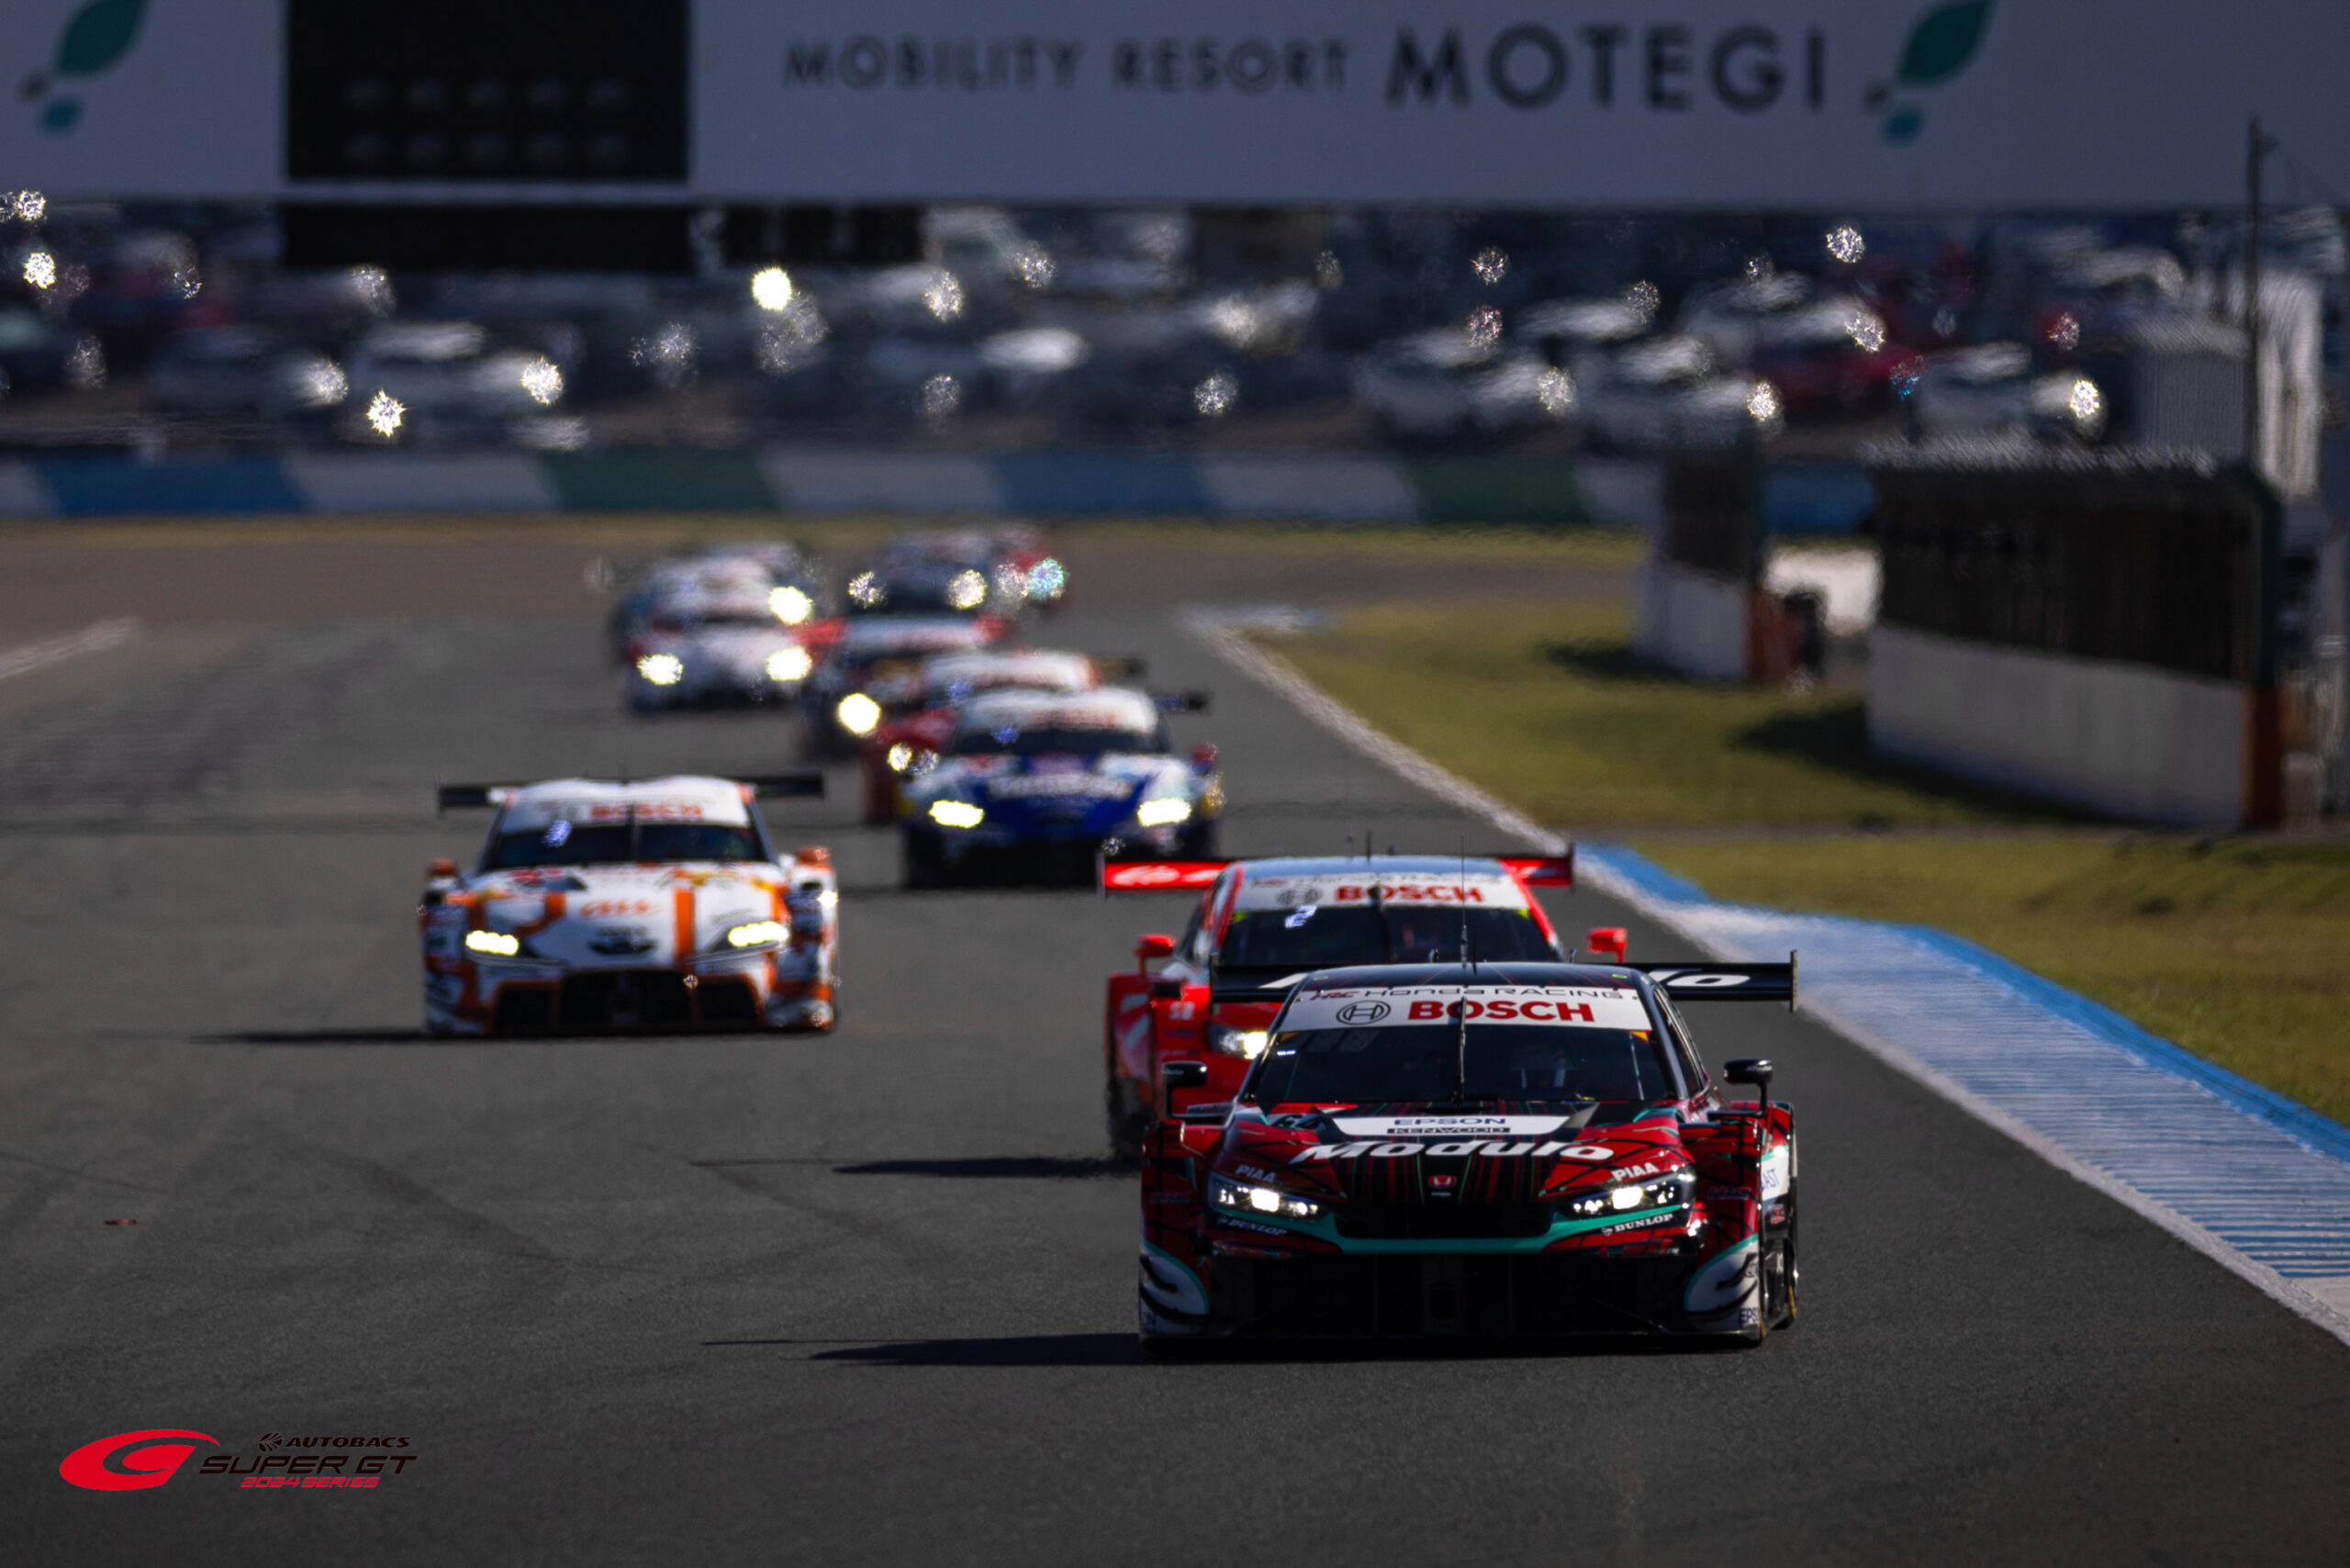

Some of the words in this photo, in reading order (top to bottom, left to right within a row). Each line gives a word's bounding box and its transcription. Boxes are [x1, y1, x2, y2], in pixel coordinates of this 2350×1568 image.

[783, 38, 1083, 90] MOBILITY
[1112, 38, 1353, 90] RESORT
[1384, 23, 1826, 110] MOTEGI
[1335, 884, 1483, 902] BOSCH
[1494, 987, 1623, 1000] RACING
[1407, 999, 1595, 1023] BOSCH
[1393, 1117, 1506, 1126] EPSON
[1289, 1139, 1615, 1162] Modulo
[1236, 1164, 1277, 1183] PIAA
[1611, 1161, 1659, 1182] PIAA
[1228, 1218, 1287, 1236] DUNLOP
[1614, 1213, 1674, 1233] DUNLOP
